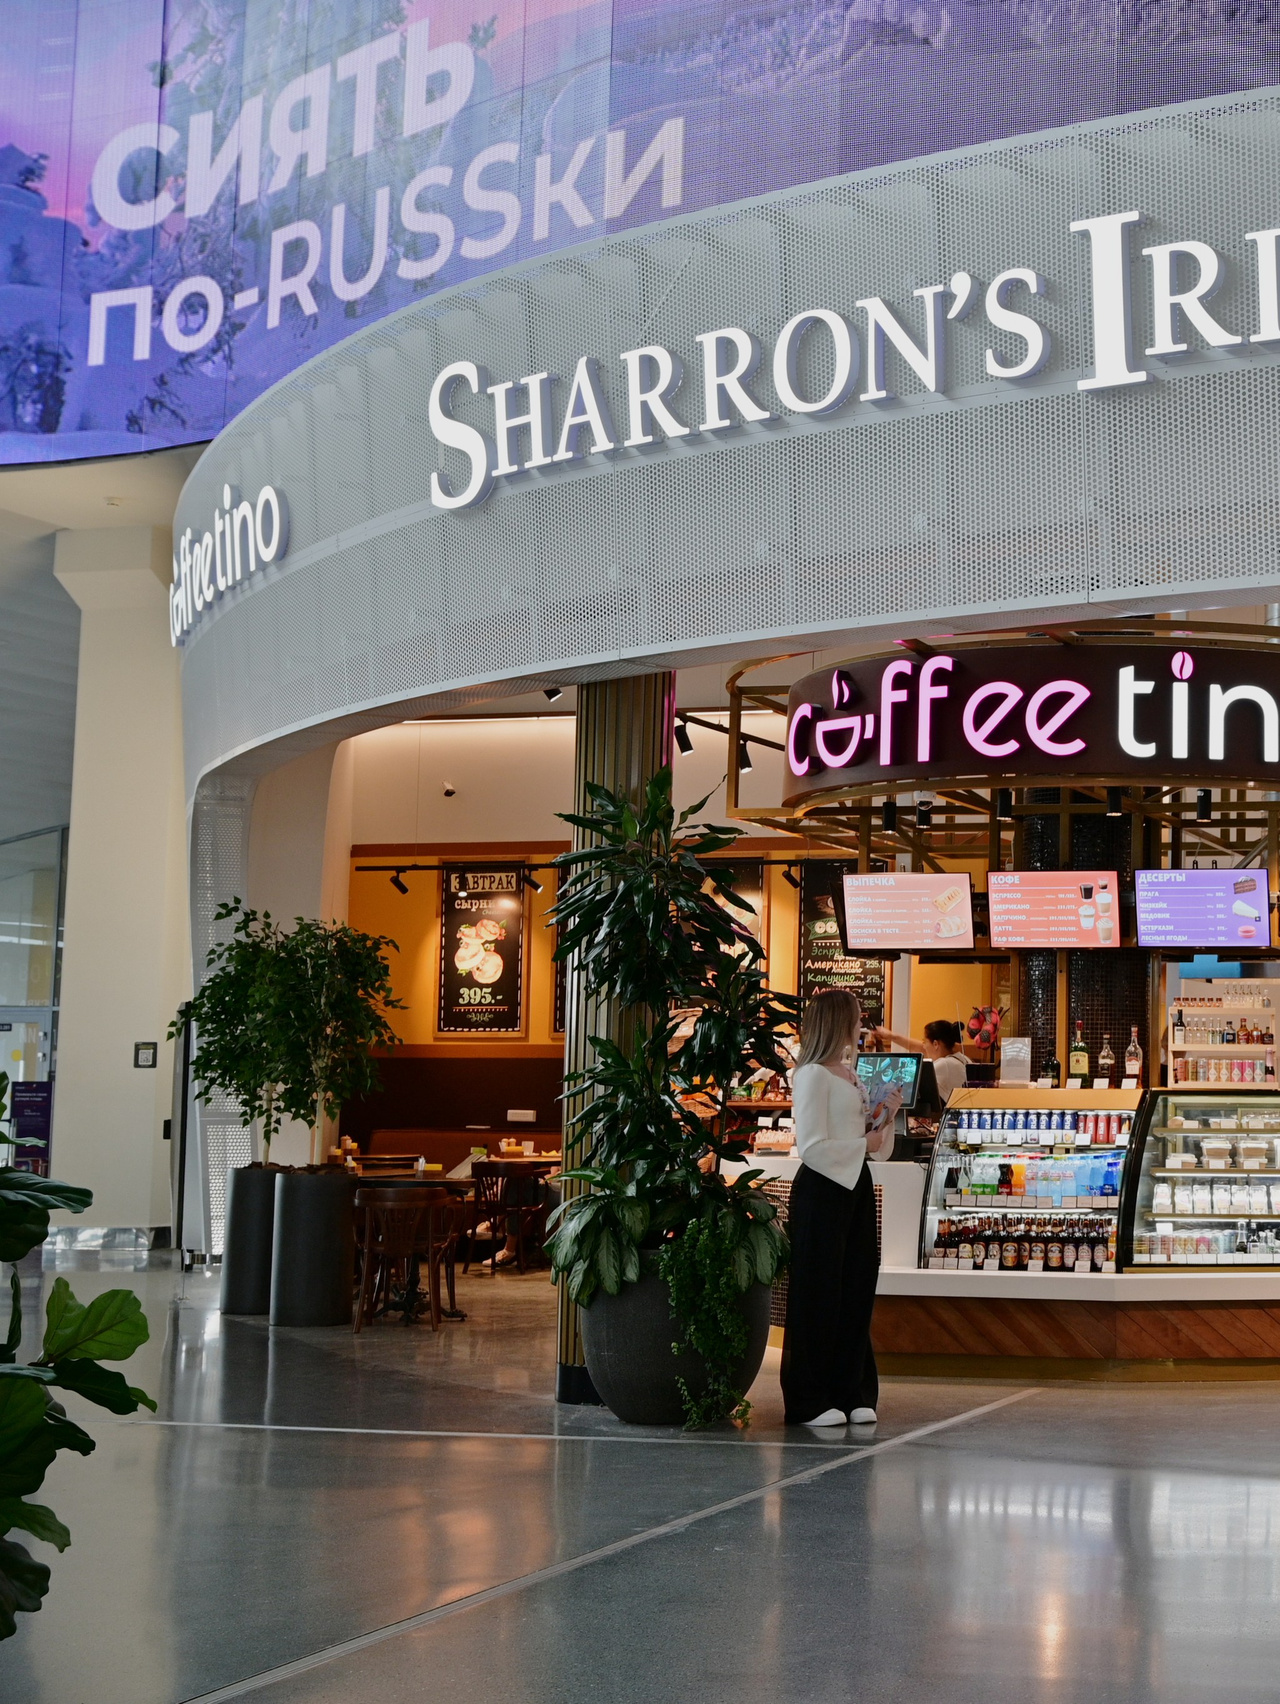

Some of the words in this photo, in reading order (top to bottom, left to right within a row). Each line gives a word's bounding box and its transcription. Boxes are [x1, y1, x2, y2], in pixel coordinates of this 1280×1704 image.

[846, 877, 895, 886] ВЫПЕЧКА
[991, 875, 1020, 884] КОФЕ
[1138, 873, 1186, 883] ДЕСЕРТЫ
[805, 959, 861, 971] Американо
